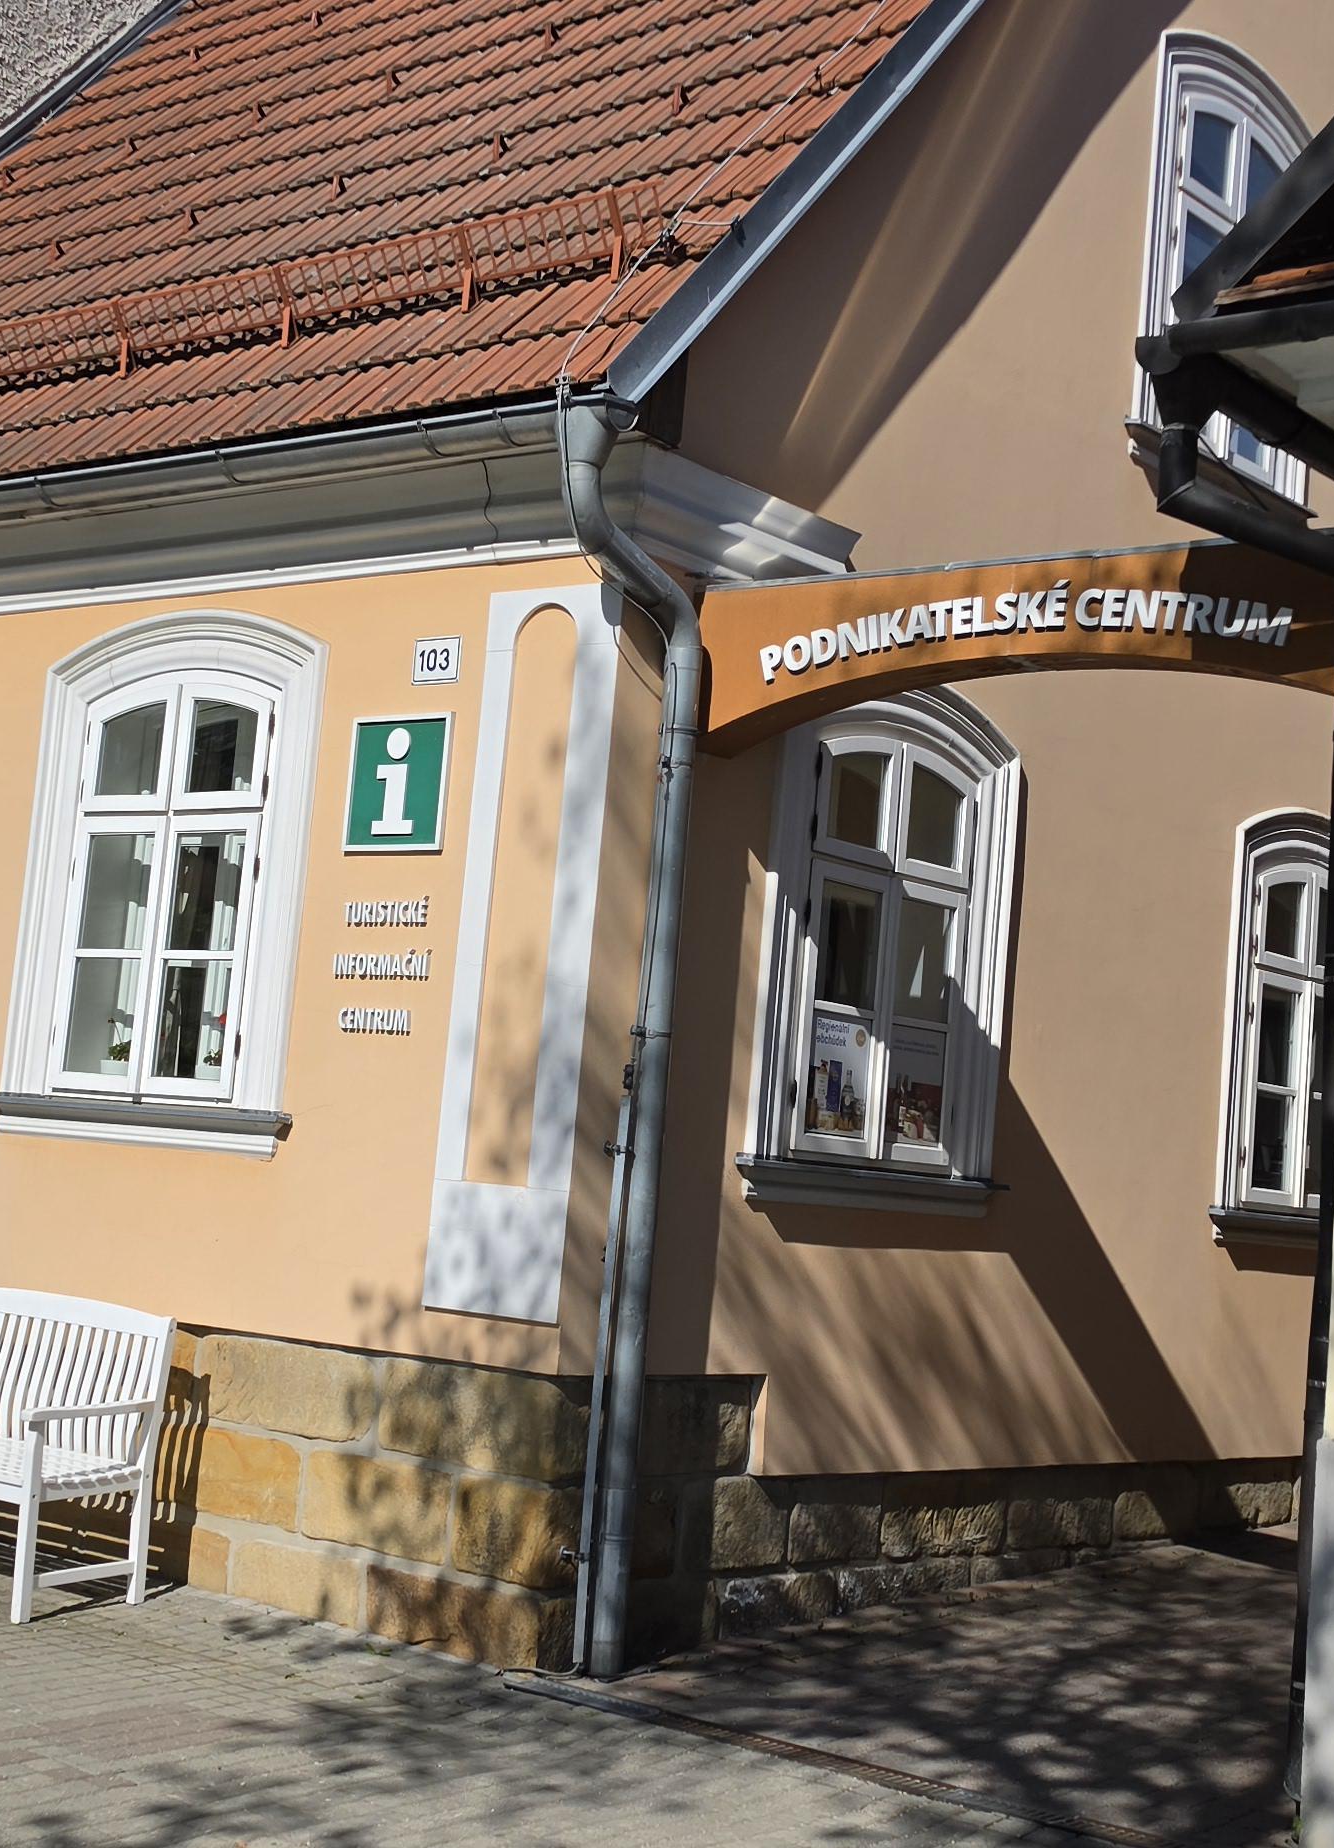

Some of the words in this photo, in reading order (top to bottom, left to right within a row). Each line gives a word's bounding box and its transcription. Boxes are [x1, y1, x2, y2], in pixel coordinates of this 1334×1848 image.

[759, 578, 1073, 684] PODNIKATELSKÉ
[1075, 587, 1294, 648] CENTRUM
[418, 647, 451, 674] 103
[344, 896, 430, 926] TURISTICKÉ
[333, 949, 432, 979] INFORMAČNÍ
[338, 1007, 411, 1034] CENTRUM
